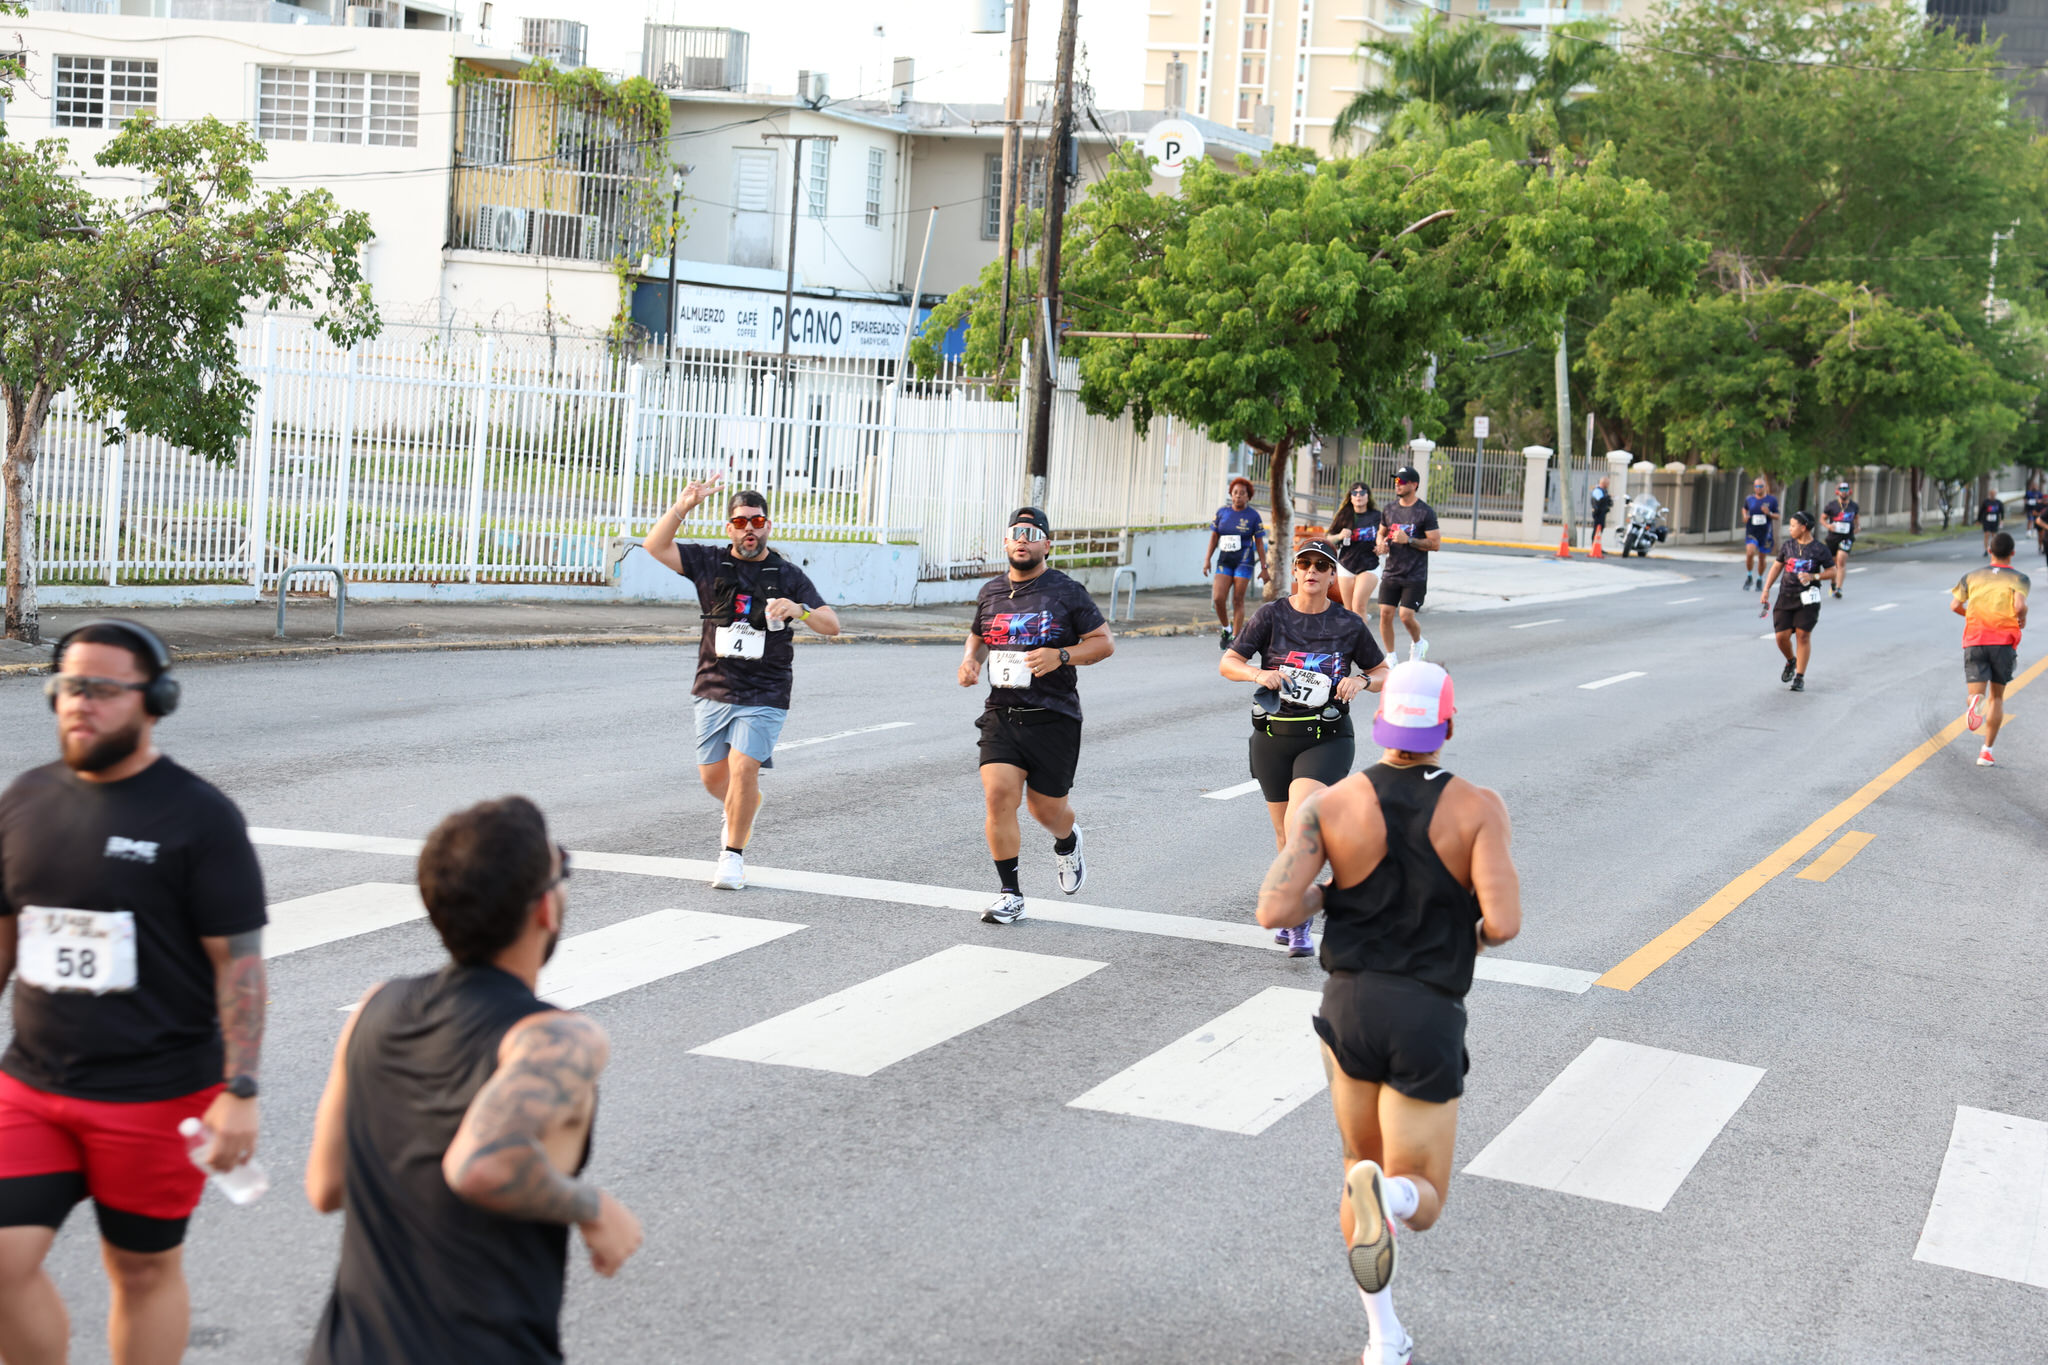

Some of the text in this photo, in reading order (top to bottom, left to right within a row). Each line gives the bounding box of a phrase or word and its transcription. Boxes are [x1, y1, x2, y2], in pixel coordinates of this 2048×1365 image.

[1166, 141, 1180, 160] P
[680, 305, 725, 323] ALMUERZO
[737, 308, 758, 326] CAFÉ
[737, 327, 757, 338] COFFEE
[772, 306, 842, 345] PCANO
[851, 320, 900, 336] EMPAREDADOS
[989, 613, 1039, 636] 5K
[733, 639, 744, 652] 4
[1285, 651, 1332, 673] 5K
[1003, 668, 1010, 681] 5
[1291, 686, 1313, 701] 57
[57, 948, 96, 978] 58
